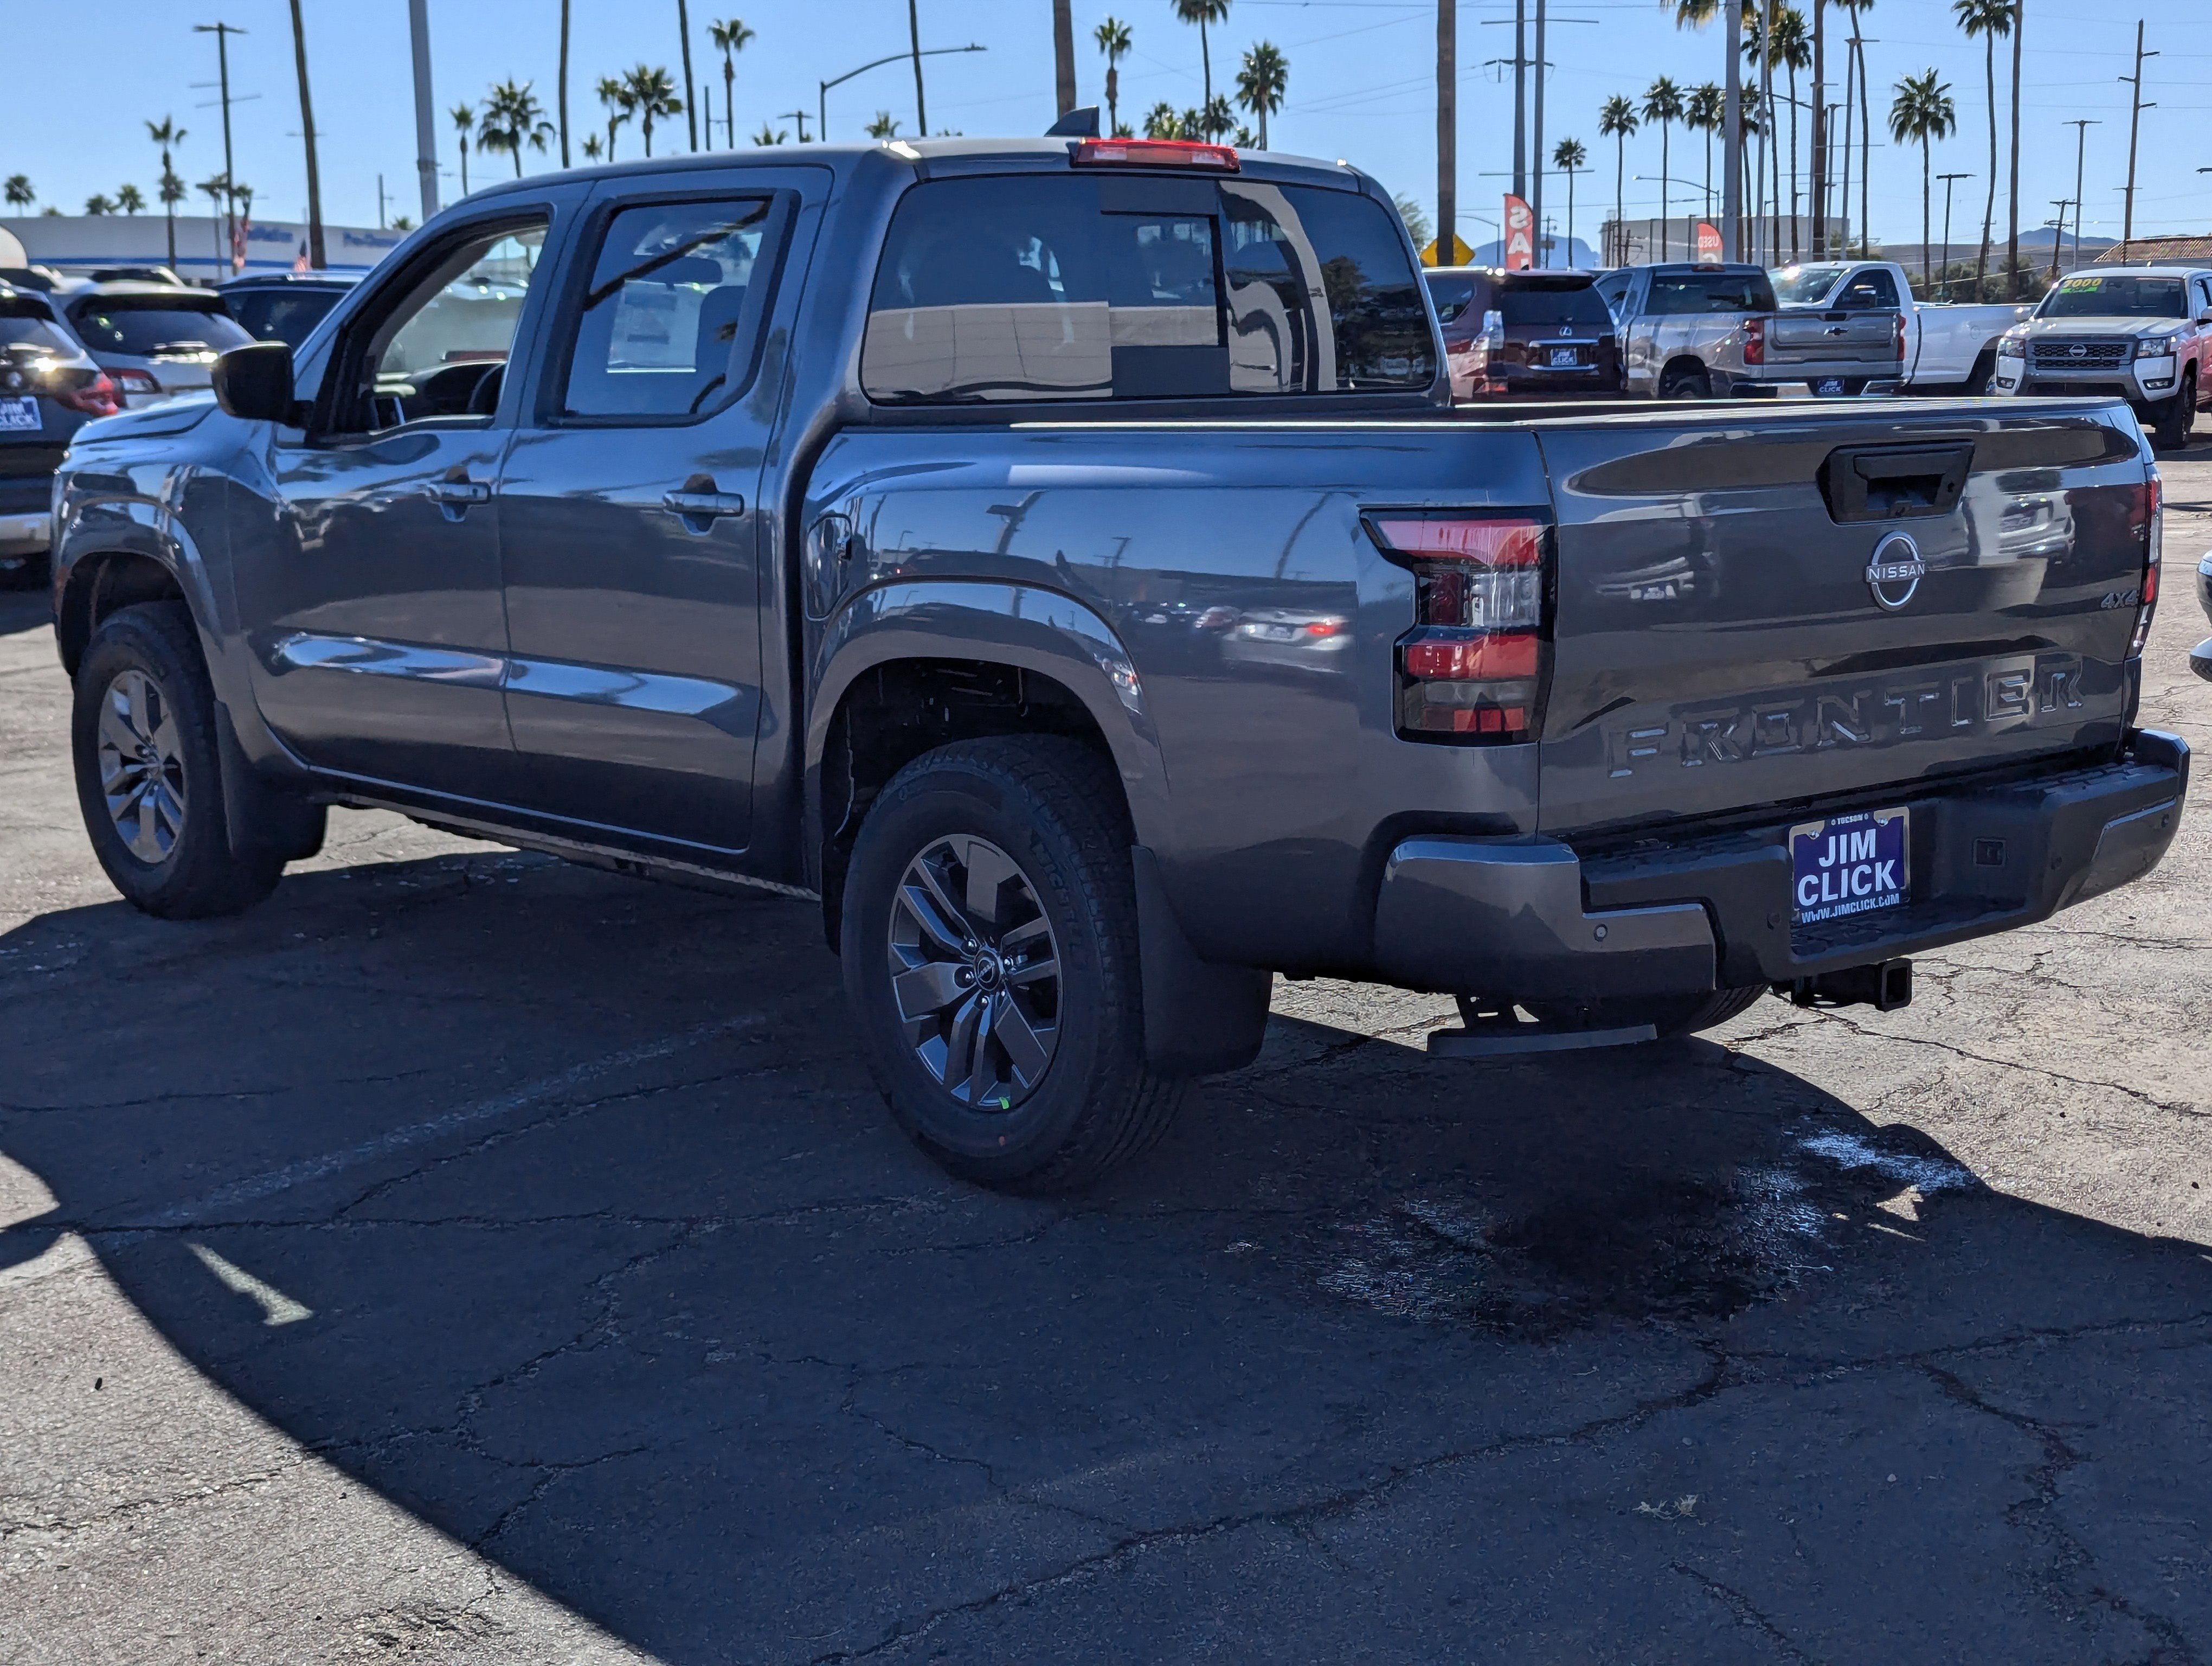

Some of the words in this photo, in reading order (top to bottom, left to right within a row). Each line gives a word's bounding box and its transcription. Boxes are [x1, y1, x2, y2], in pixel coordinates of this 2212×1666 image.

[1869, 563, 1925, 580] NISSAN
[1607, 655, 2084, 779] FRONTIER
[1818, 828, 1876, 867] JIM
[1797, 859, 1897, 906] CLICK
[1802, 893, 1900, 924] WWW.JIMCLICK.COM
